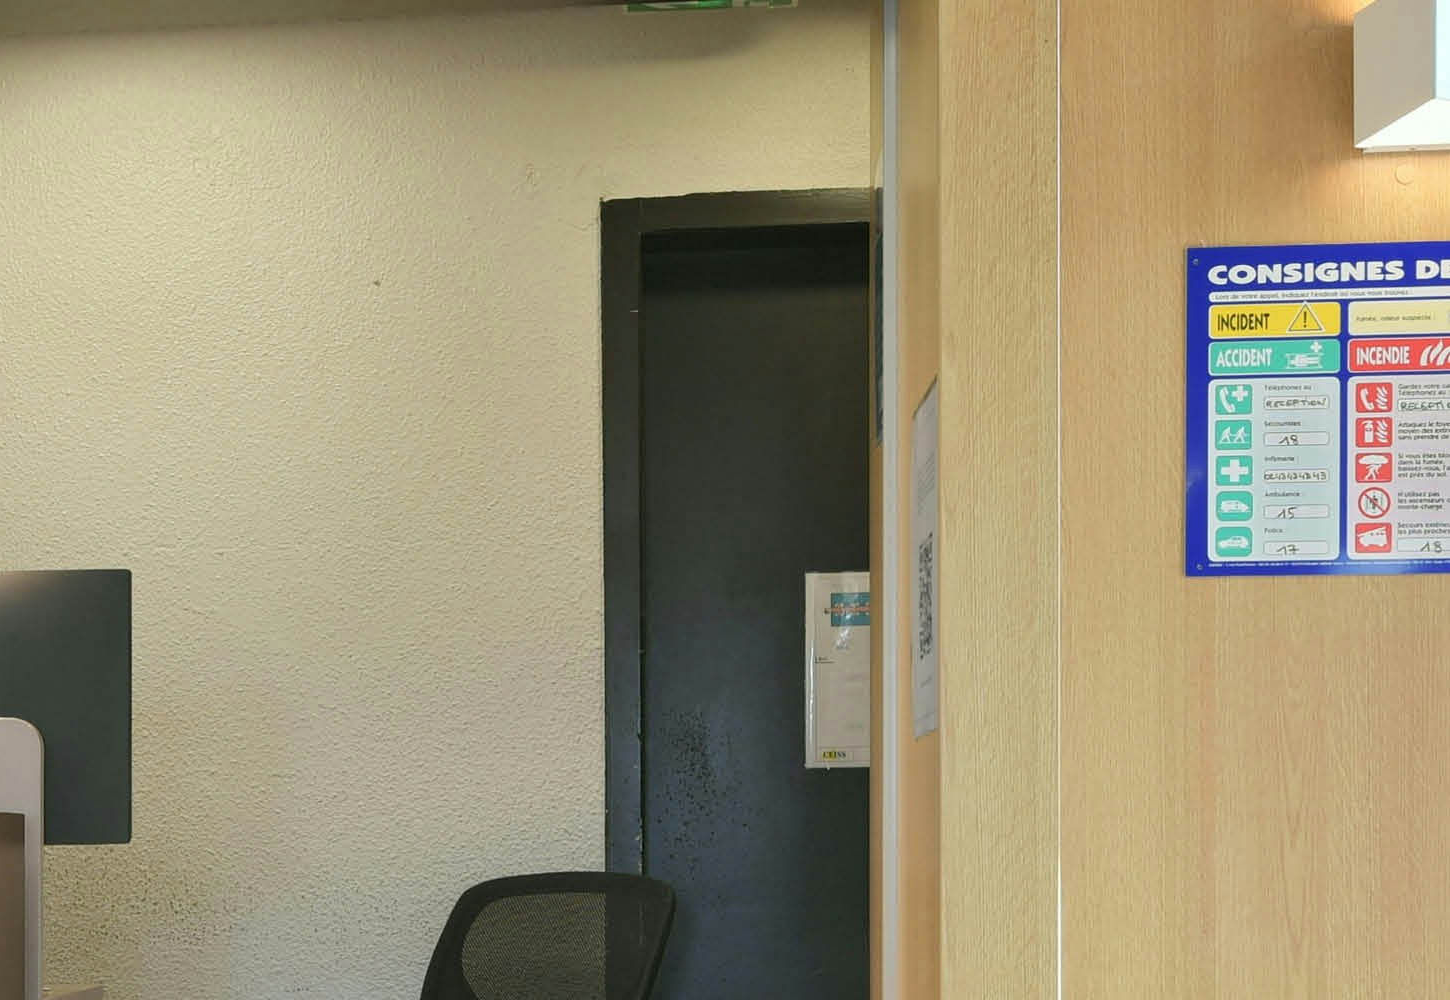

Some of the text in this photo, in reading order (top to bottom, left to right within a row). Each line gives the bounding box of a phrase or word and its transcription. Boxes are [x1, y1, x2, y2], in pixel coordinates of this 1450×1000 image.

[1207, 259, 1450, 285] CONSIGNES DE
[1217, 313, 1270, 331] INCIDENT
[1215, 346, 1272, 367] ACCIDENT
[1356, 345, 1410, 366] INCENDIE
[1265, 397, 1327, 408] RECEPTION
[1278, 434, 1299, 446] 18
[1277, 506, 1297, 520] 15
[1276, 544, 1300, 555] 17
[1420, 541, 1443, 554] 18
